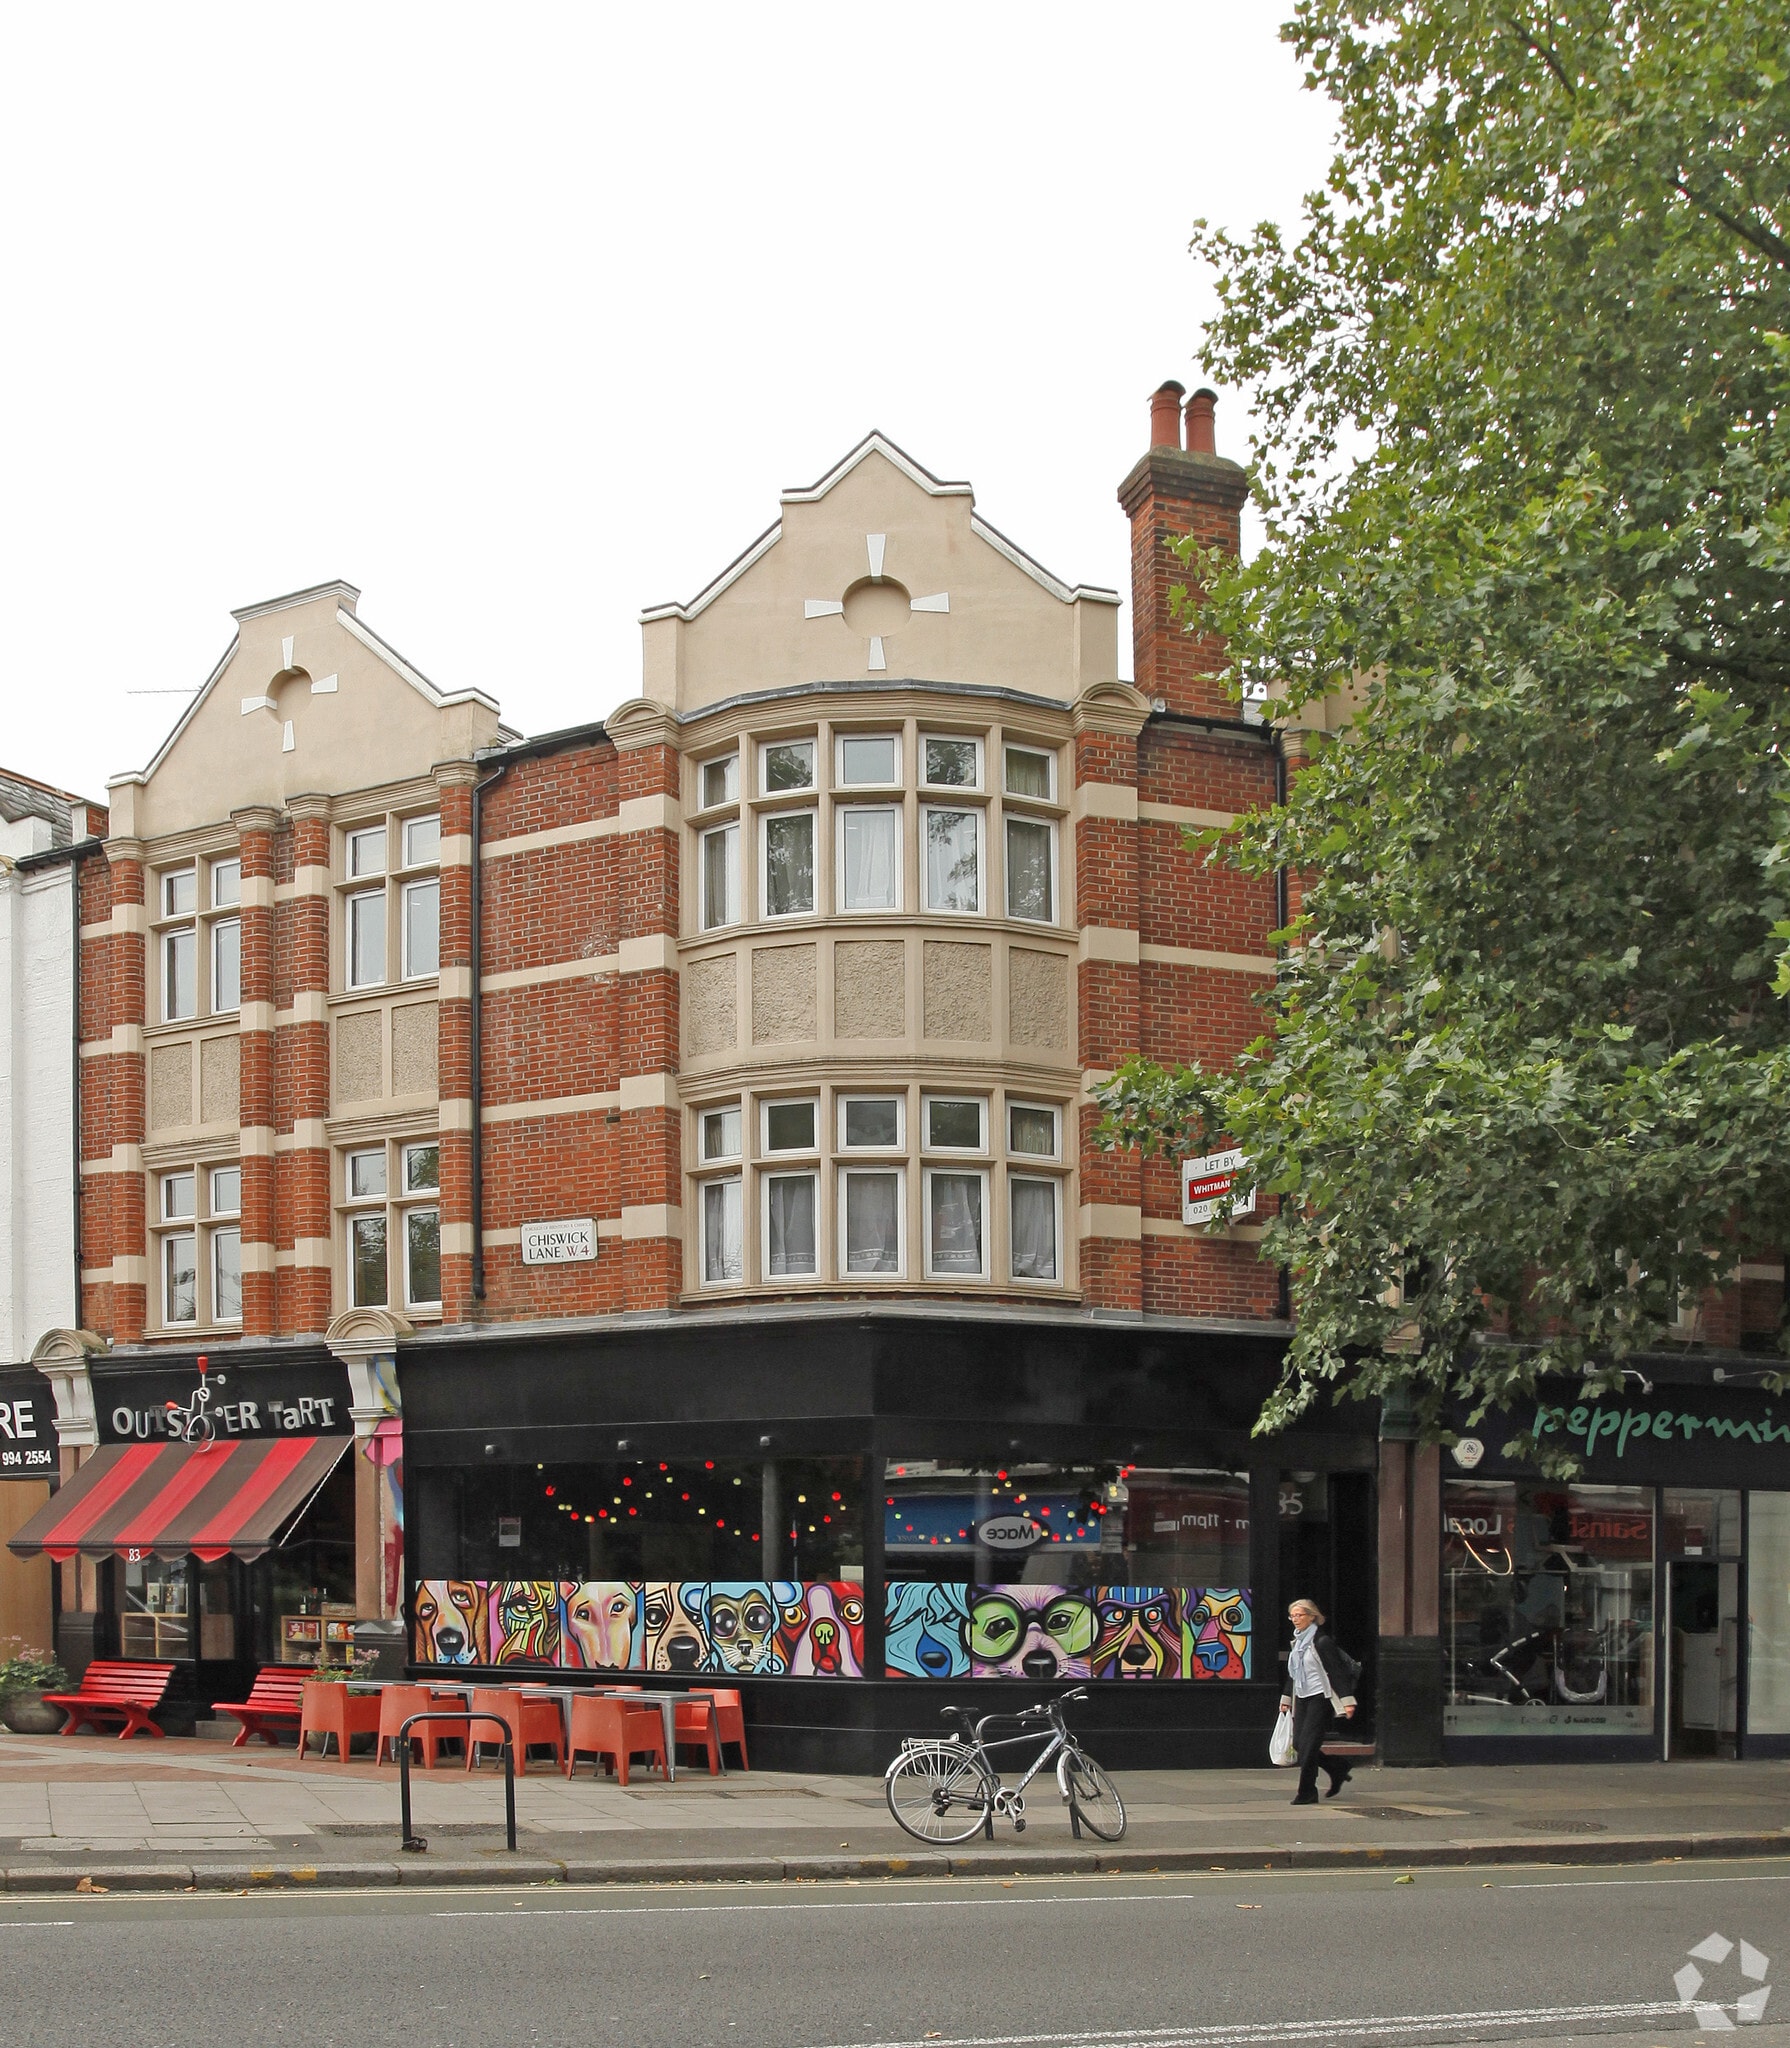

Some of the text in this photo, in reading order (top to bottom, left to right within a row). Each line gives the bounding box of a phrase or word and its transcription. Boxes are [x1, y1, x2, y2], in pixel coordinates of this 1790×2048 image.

[1205, 1156, 1236, 1171] LET BY
[1193, 1179, 1231, 1195] WHITMAN
[1193, 1205, 1208, 1215] 020
[528, 1231, 589, 1247] CHISWICK
[112, 1402, 262, 1439] OUTSIER
[1533, 1406, 1790, 1458] peppermin
[2, 1450, 52, 1466] 994 2554
[128, 1548, 141, 1562] 83
